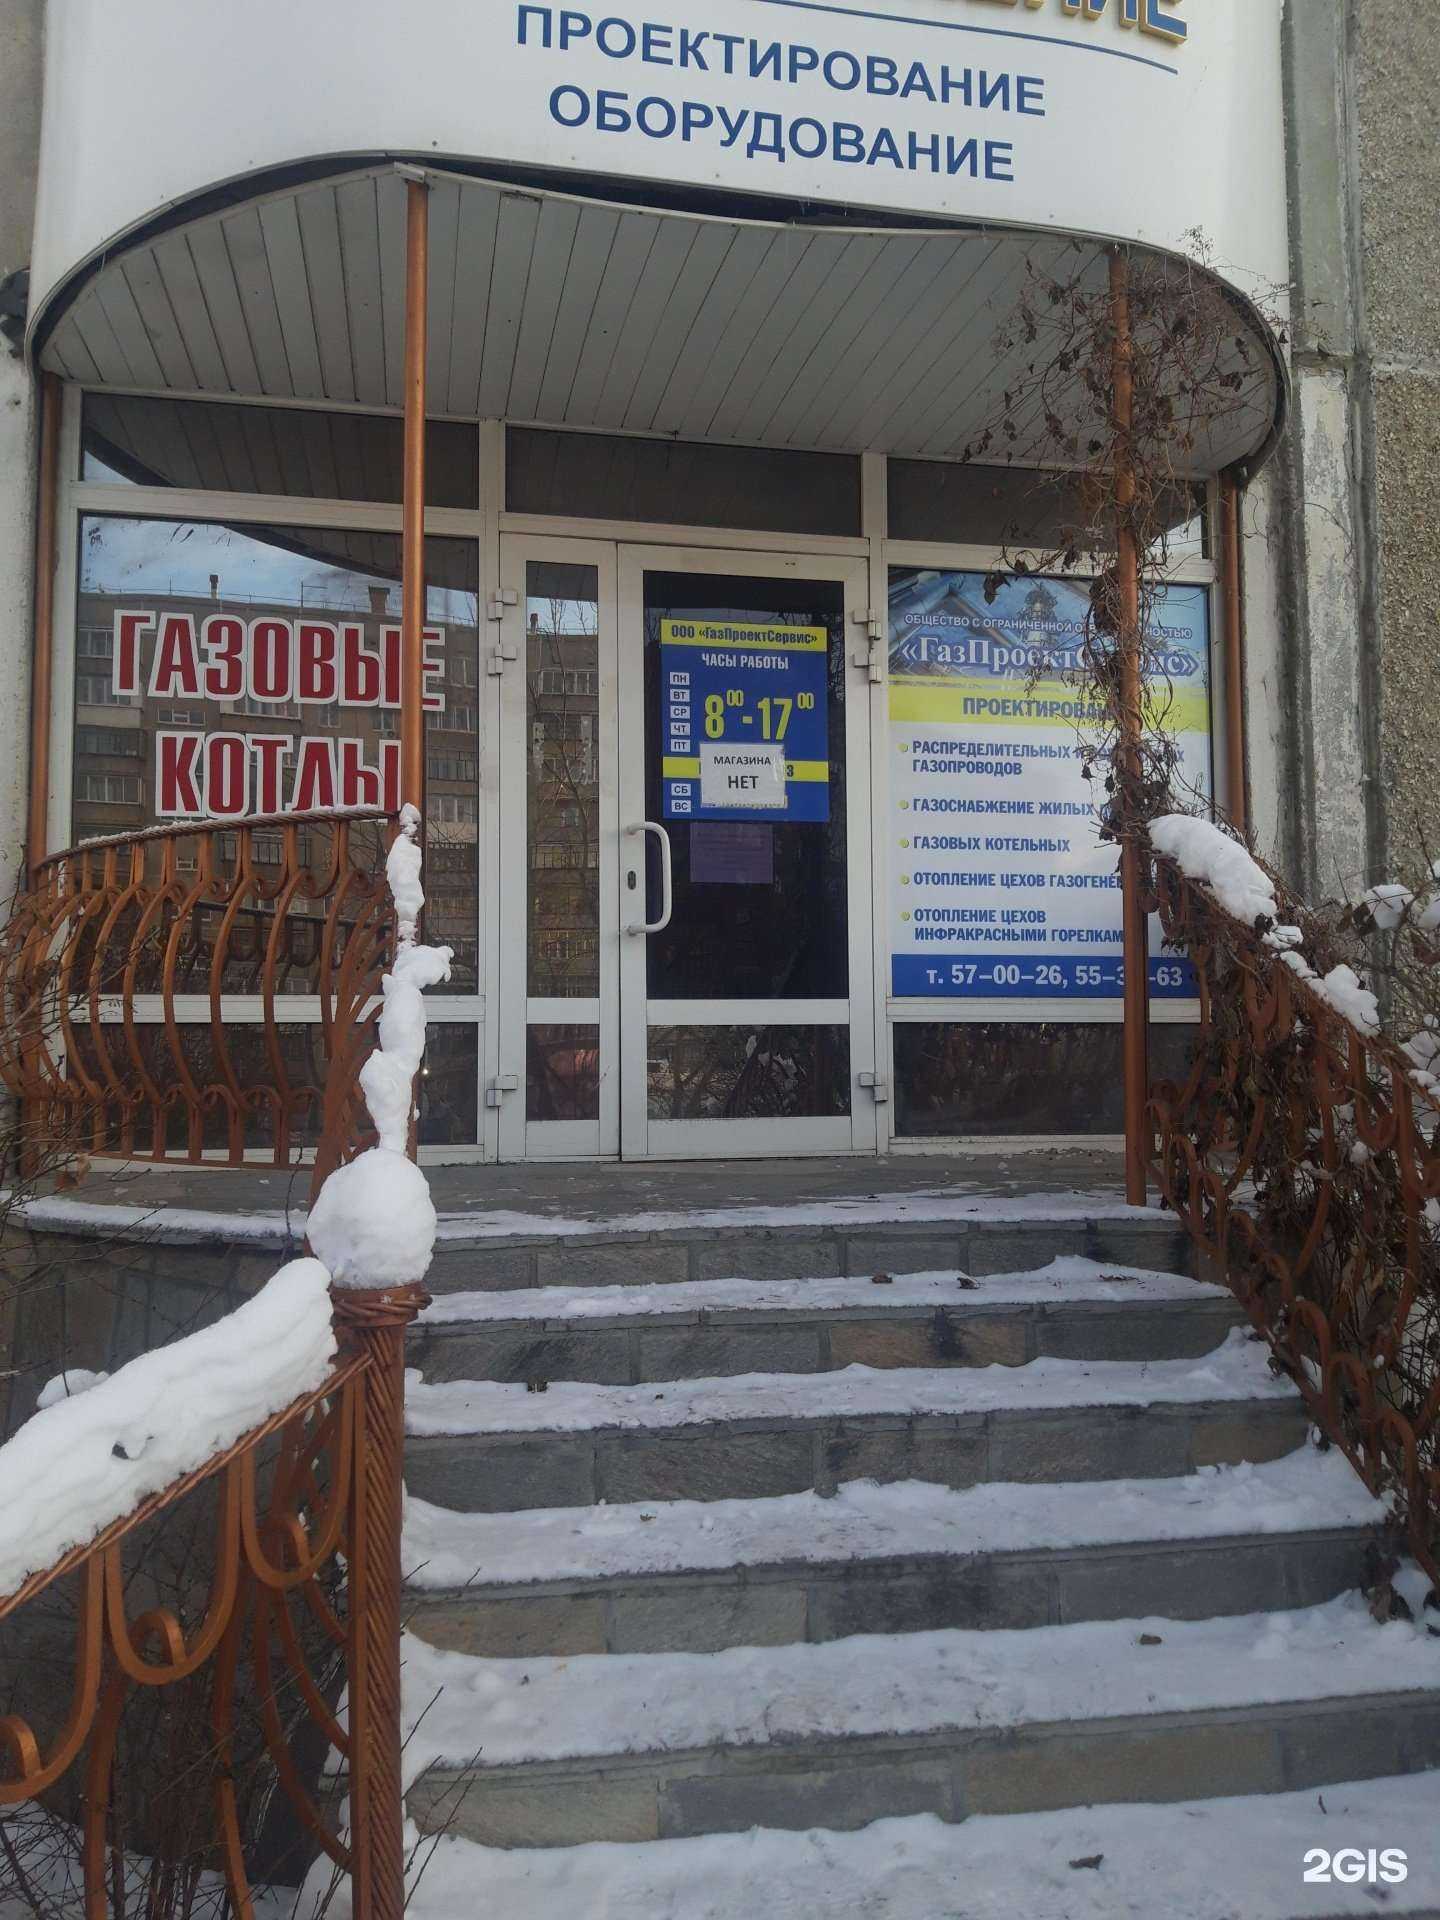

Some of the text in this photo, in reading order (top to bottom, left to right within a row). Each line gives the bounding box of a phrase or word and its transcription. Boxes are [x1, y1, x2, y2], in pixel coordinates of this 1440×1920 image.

[516, 4, 1046, 117] ПРОЕКТИРОВАНИЕ
[549, 84, 1015, 183] ОБОРУДОВАНИЕ
[904, 613, 970, 627] ОБЩЕСТВО
[972, 616, 981, 627] С
[983, 617, 1072, 632] ОГРАНИЧЕННОЙ
[671, 625, 817, 644] ООО «ГазПроектСервис»
[112, 609, 446, 712] ГАЗОВЫЕ
[702, 653, 789, 669] ЧАСЫ РАБОТЫ
[672, 674, 687, 683] ПН
[673, 691, 687, 700] ВТ
[673, 708, 688, 717] СР
[673, 724, 687, 734] ЧТ
[674, 741, 688, 750] ПТ
[912, 740, 1070, 759] РАСПРЕДЕЛИТЕЛЬНЫХ
[713, 756, 771, 765] МАГАЗИНА
[912, 759, 1022, 776] ГАЗОПРОВОДОВ
[155, 731, 402, 818] КОТЛЫ
[728, 775, 759, 789] НЕТ
[674, 785, 688, 794] СБ
[674, 802, 688, 811] ВС
[912, 798, 1035, 815] ГАЗОСНАБЖЕНИЕ
[1038, 800, 1094, 816] ЖИЛЫХ
[913, 835, 1071, 852] ГАЗОВЫХ КОТЕЛЬНЫХ
[913, 871, 996, 887] ОТОПЛЕНИЕ
[1000, 873, 1045, 889] ЦЕХОВ
[914, 908, 1046, 924] ОТОПЛЕНИЕ ЦЕХОВ
[914, 926, 1047, 942] ИНФРАКРАСНЫМИ
